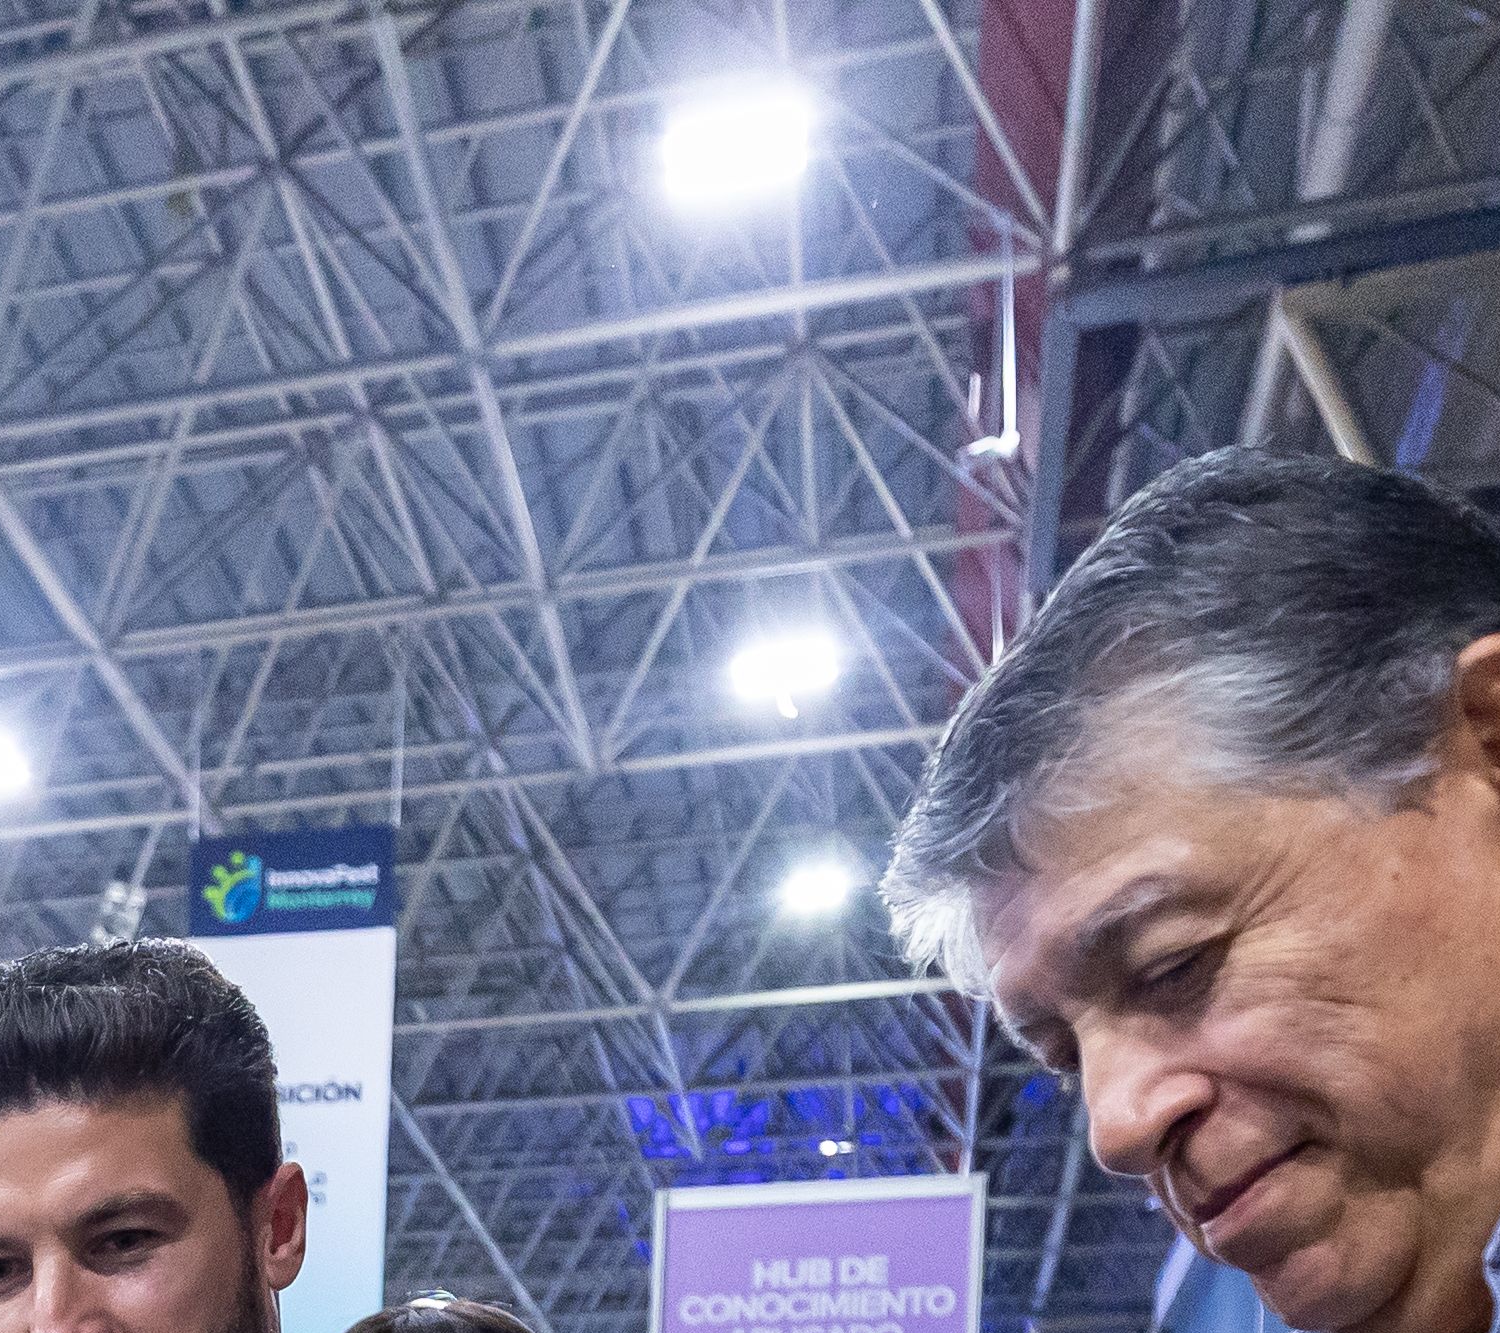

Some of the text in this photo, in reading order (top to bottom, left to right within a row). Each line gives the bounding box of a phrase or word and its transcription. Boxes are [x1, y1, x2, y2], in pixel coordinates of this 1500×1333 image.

[753, 1254, 889, 1288] HUB DE
[679, 1285, 956, 1325] CONOCIMIENTO
